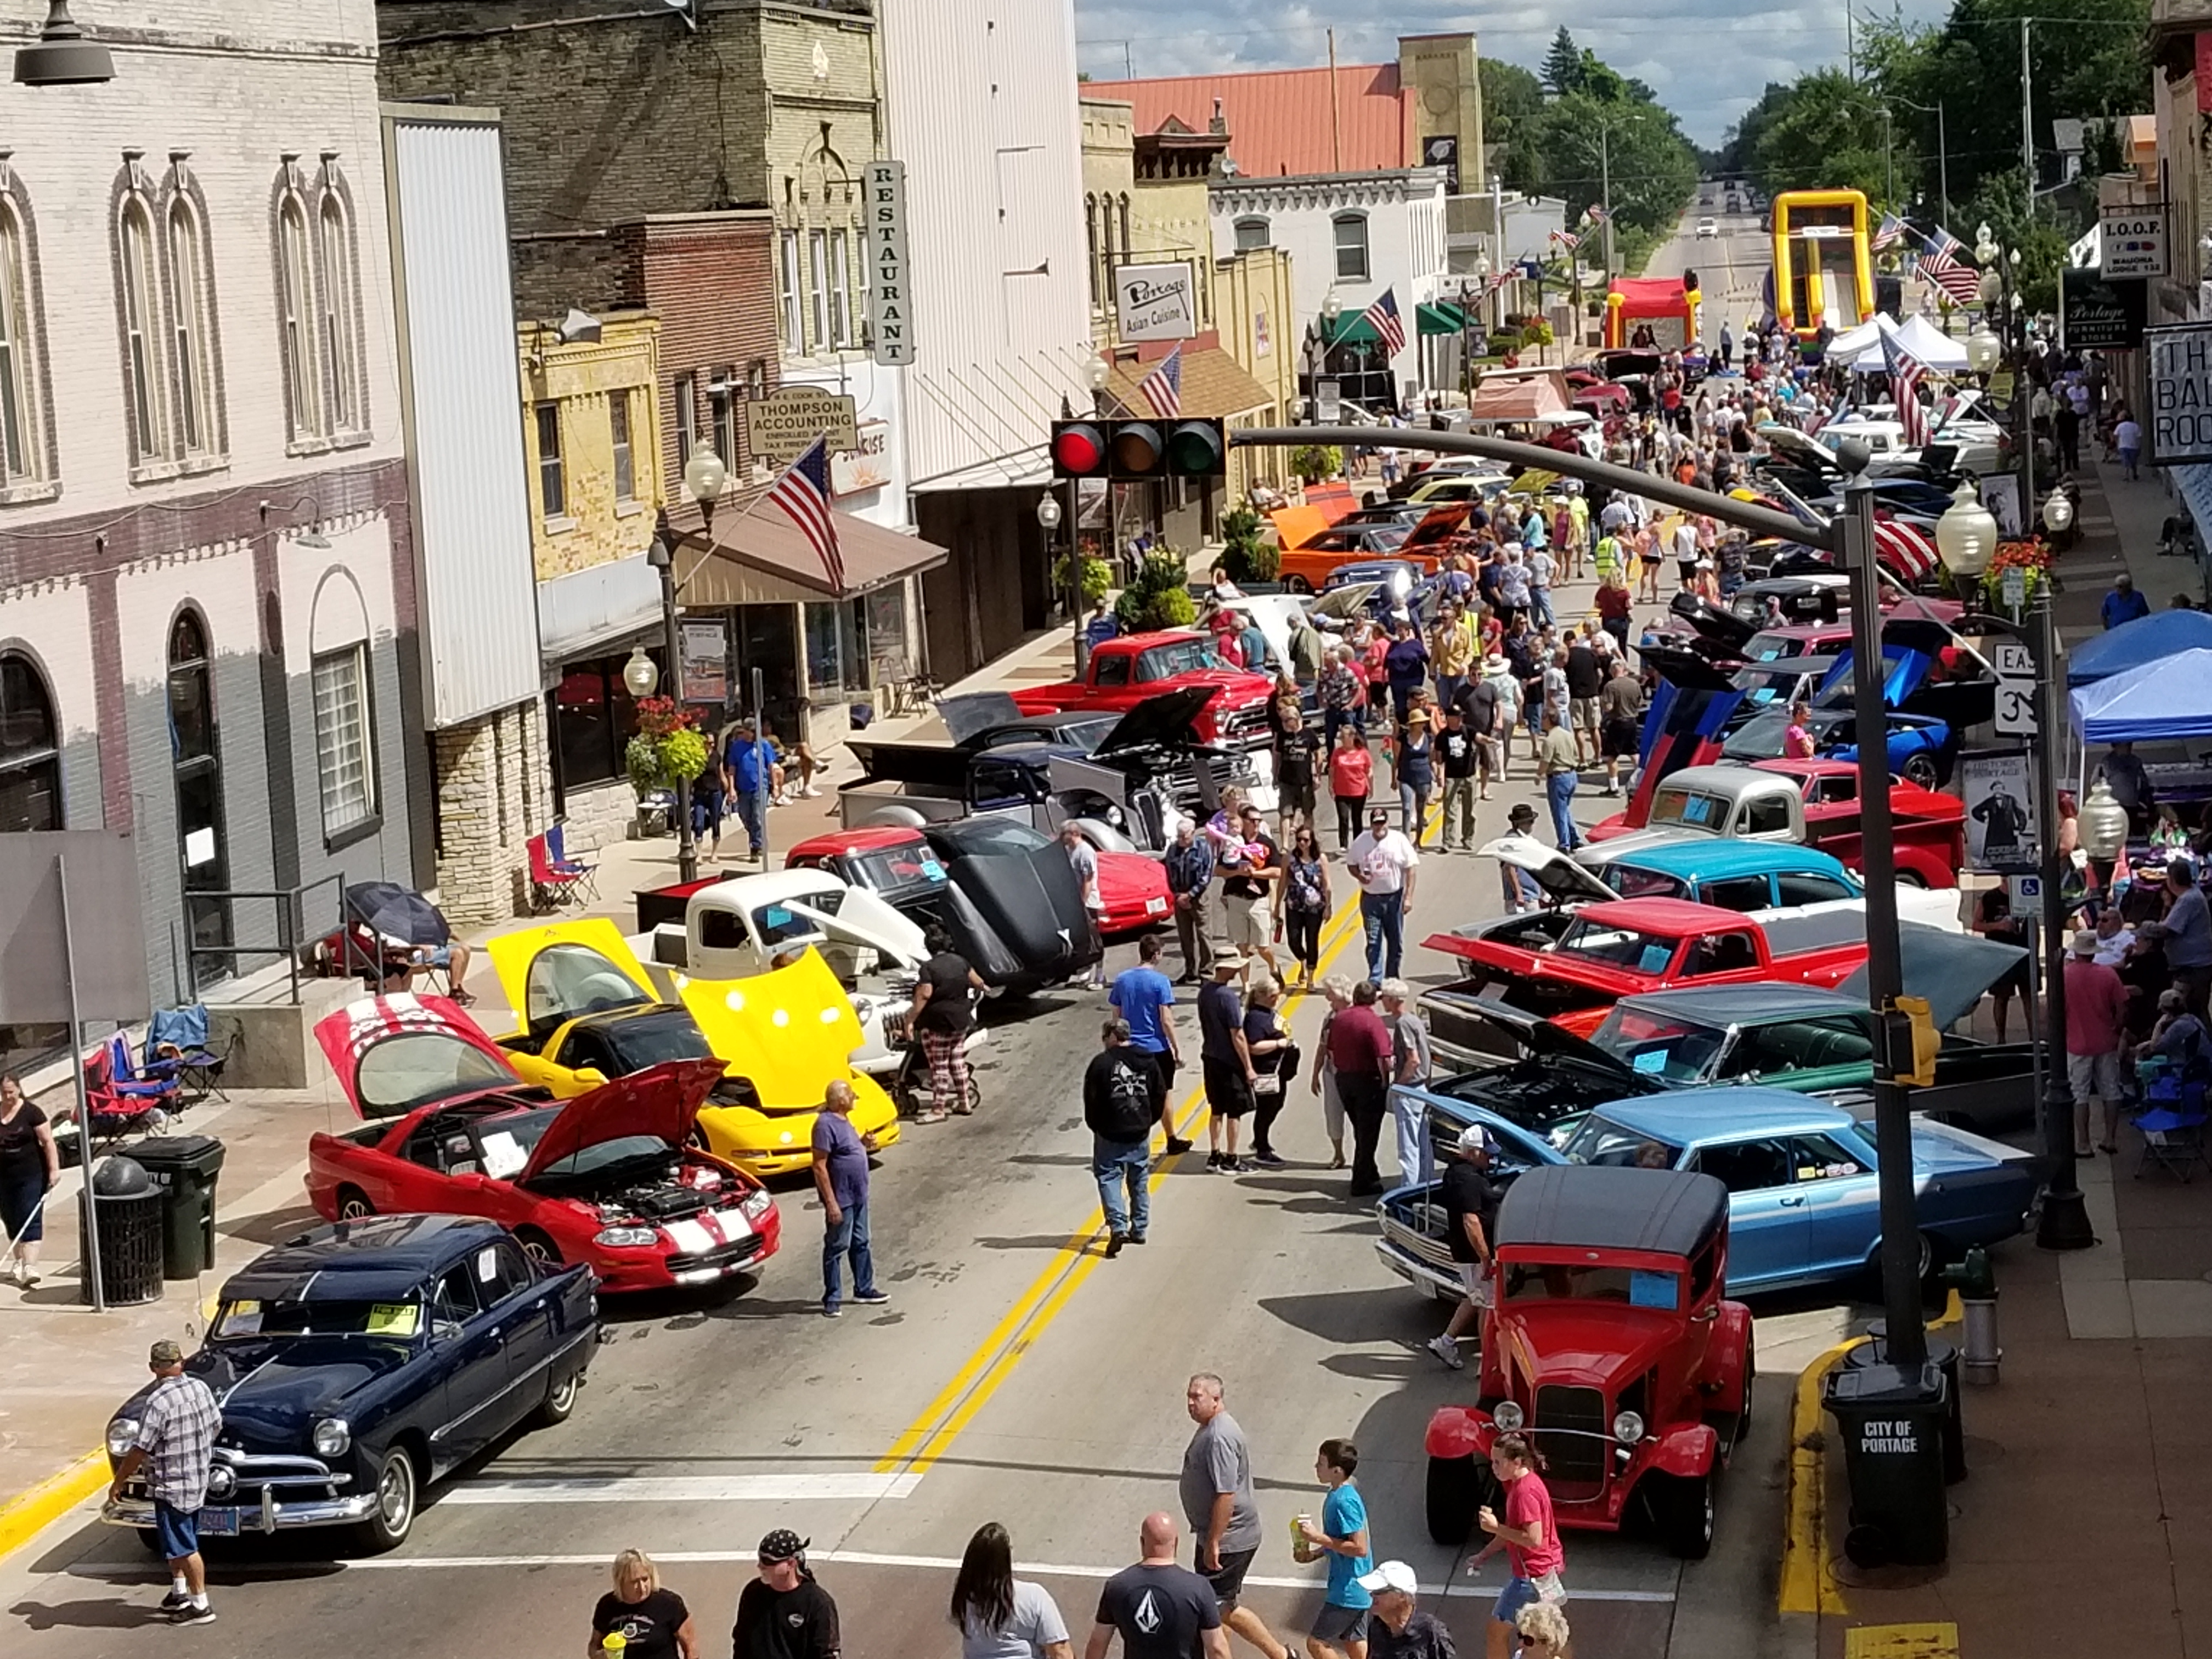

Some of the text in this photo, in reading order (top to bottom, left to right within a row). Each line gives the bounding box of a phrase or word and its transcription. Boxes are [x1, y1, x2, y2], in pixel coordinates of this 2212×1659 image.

[2106, 221, 2160, 236] I.O.O.F.
[874, 168, 902, 358] RESTAURANT
[2069, 304, 2125, 320] Portage
[1127, 307, 1180, 334] Asian Cuisine
[2068, 324, 2128, 334] FURNITURE
[2163, 340, 2205, 373] TH
[2157, 377, 2212, 410] BAL
[759, 401, 843, 417] THOMPSON
[754, 414, 851, 431] ACCOUNTING
[2157, 414, 2212, 447] ROO
[765, 431, 809, 439] ENROLLED
[812, 428, 840, 437] AENT
[1864, 1421, 1912, 1436] CITY OF
[1861, 1437, 1918, 1453] PORTAGE
